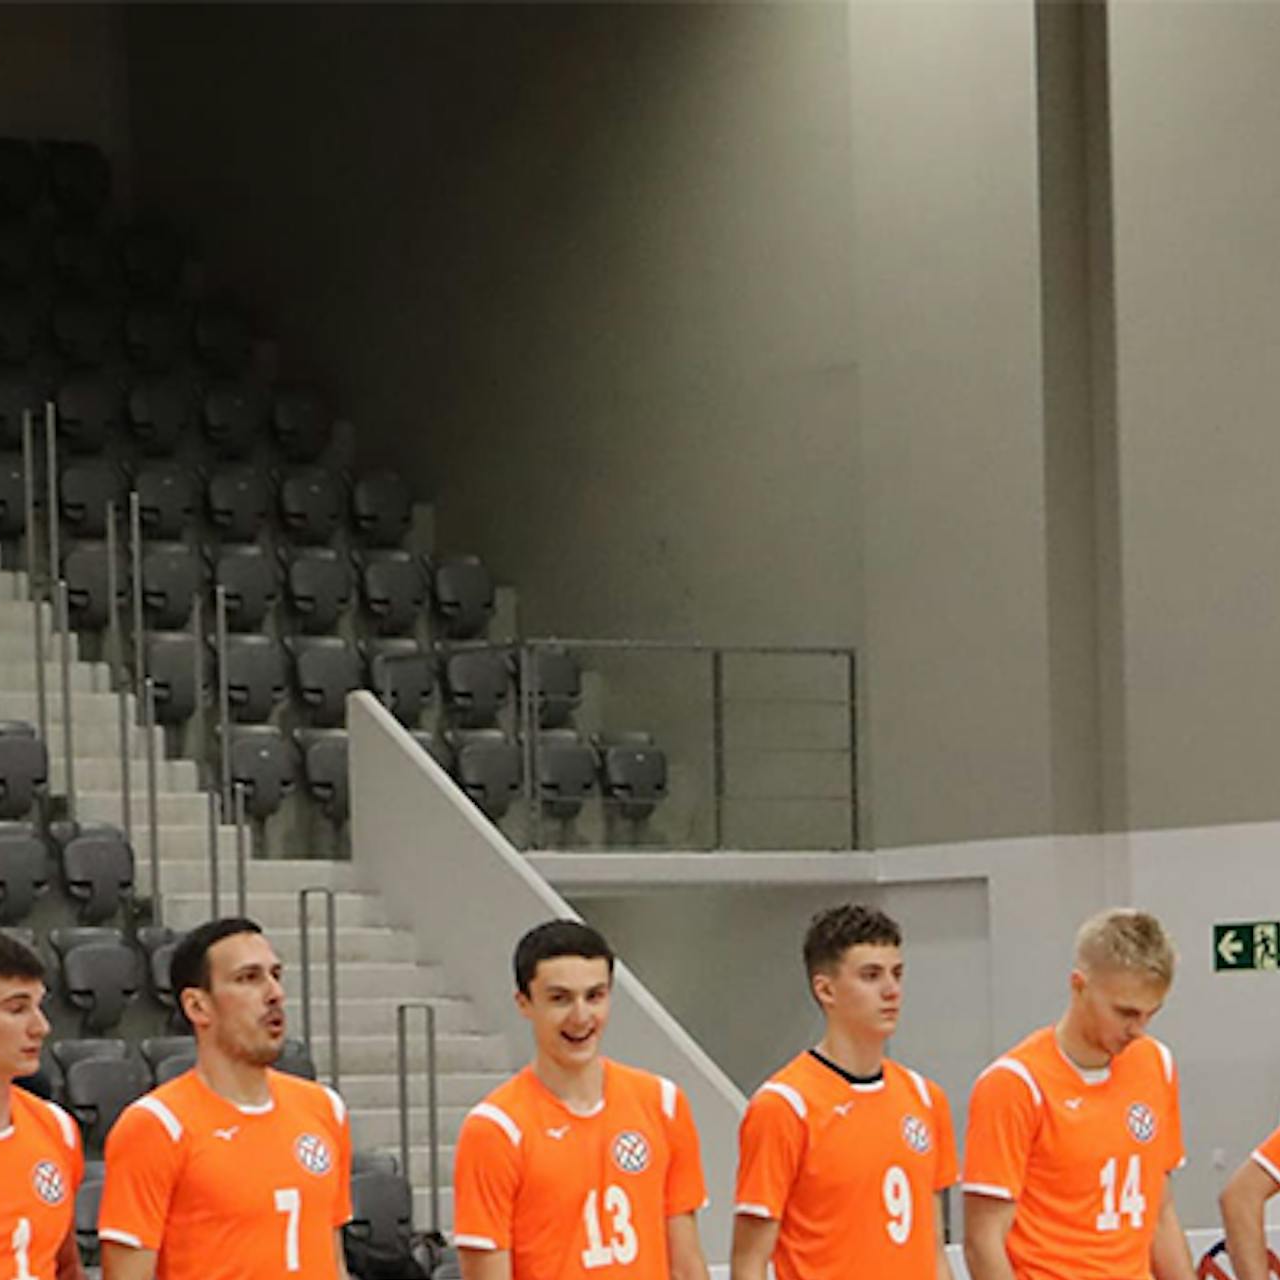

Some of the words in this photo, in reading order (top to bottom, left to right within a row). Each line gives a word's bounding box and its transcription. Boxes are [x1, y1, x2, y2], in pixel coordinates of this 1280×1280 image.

[273, 1187, 302, 1272] 7
[581, 1184, 640, 1270] 13
[882, 1165, 914, 1245] 9
[1095, 1154, 1147, 1232] 14
